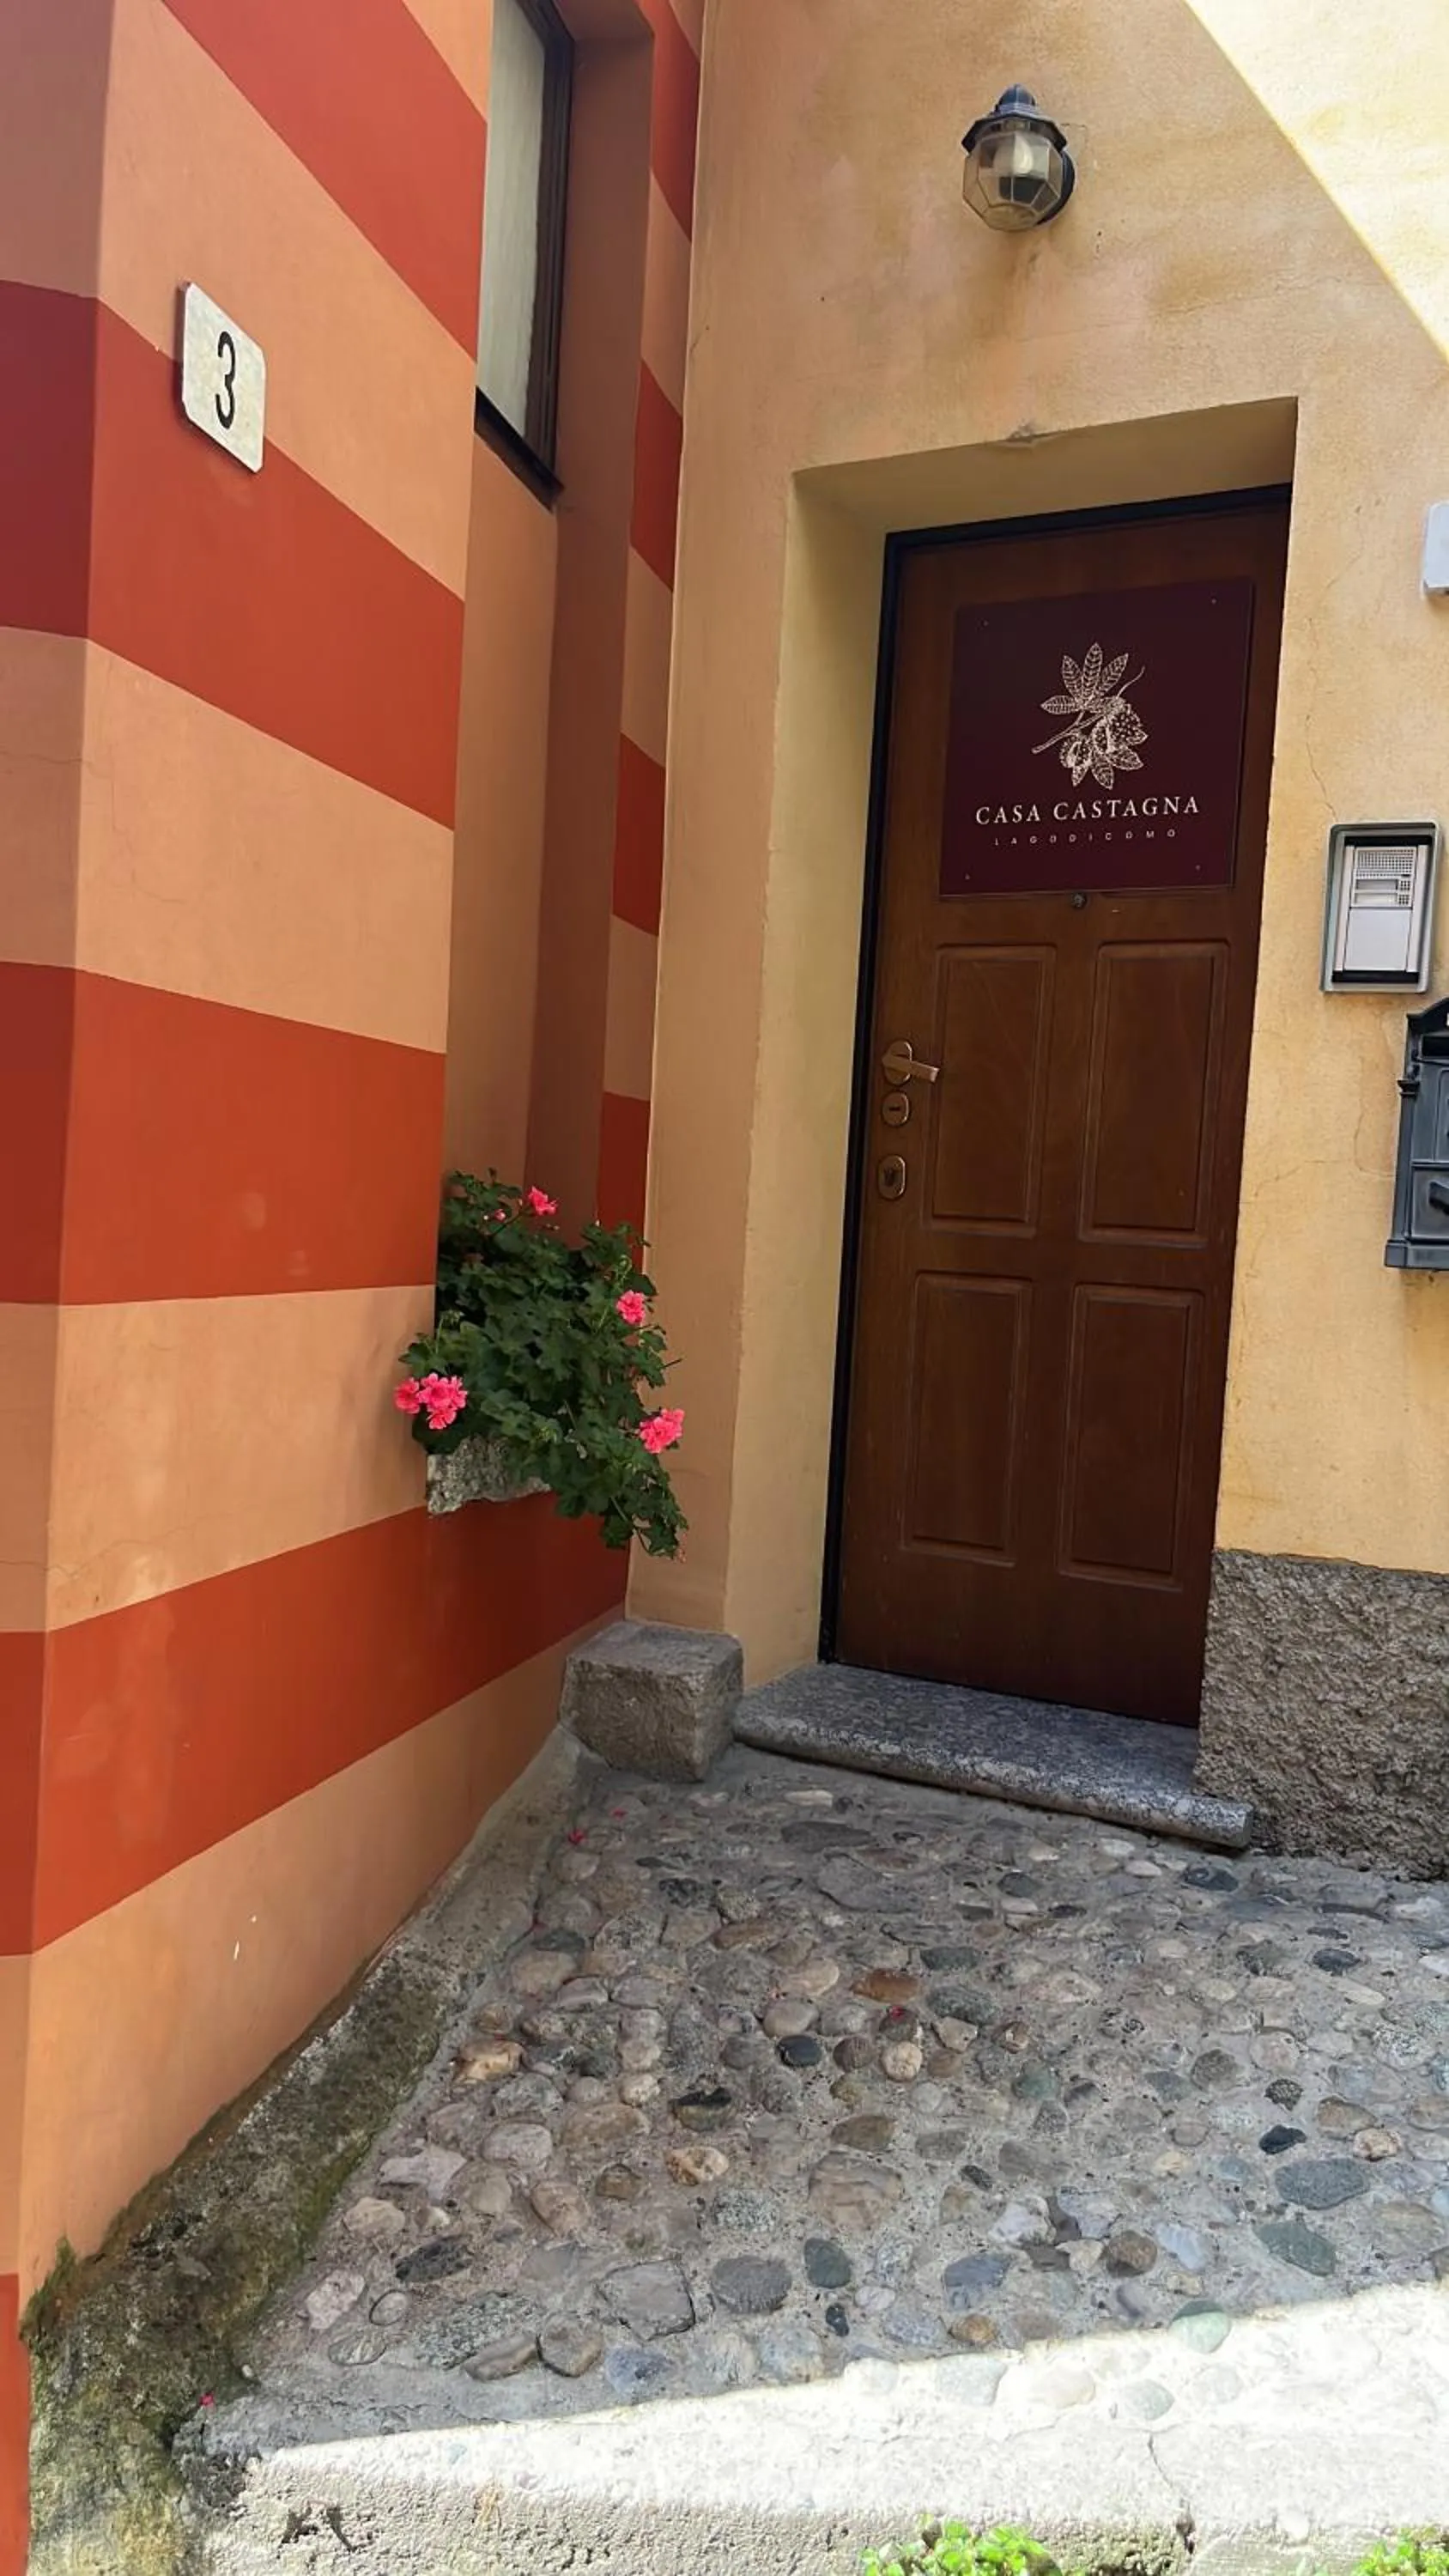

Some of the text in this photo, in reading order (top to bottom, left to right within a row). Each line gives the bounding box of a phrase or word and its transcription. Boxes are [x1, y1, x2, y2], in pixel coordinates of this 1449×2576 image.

[215, 331, 235, 429] 3
[975, 796, 1199, 824] CASA CASTAGNA
